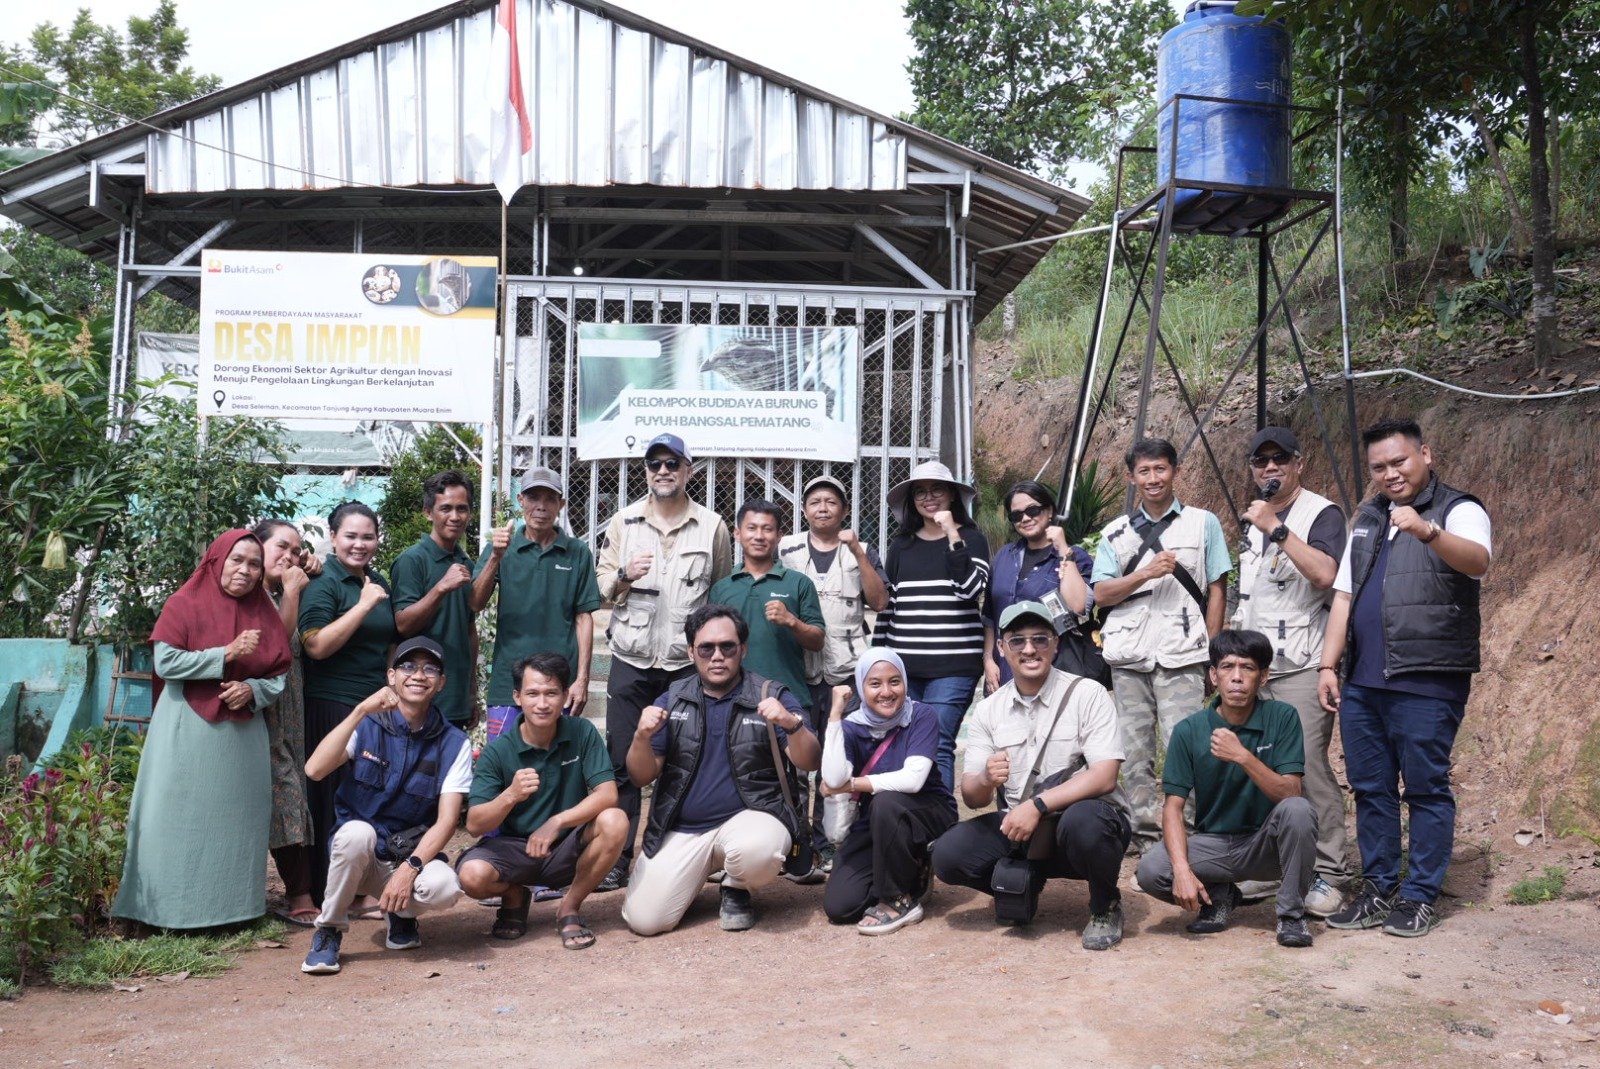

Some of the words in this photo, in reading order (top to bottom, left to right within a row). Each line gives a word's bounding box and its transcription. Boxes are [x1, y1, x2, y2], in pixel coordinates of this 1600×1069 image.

[253, 310, 313, 318] PEMBERDAYAAN
[314, 311, 363, 319] MASYARAKAT
[214, 321, 294, 362] DESA
[306, 323, 421, 365] IMPIAN
[213, 363, 250, 375] Dorong
[252, 364, 292, 374] Ekonomi
[294, 365, 327, 374] Sektor
[329, 366, 378, 376] Agrikultur
[380, 367, 416, 378] dengan
[418, 368, 453, 377] Inovasi
[213, 374, 248, 385] Menuju
[250, 375, 310, 386] Pengelolaan
[311, 376, 365, 387] Lingkungan
[366, 377, 435, 388] Berkelanjutan
[323, 405, 350, 413] Tanjung
[373, 406, 411, 414] Kabupaten
[628, 397, 697, 408] KELOMPOK
[698, 397, 764, 409] BUDIDAYA
[765, 398, 818, 409] BURUNG
[635, 415, 678, 426] PUYUH
[680, 416, 739, 427] BANGSAL
[740, 416, 811, 428] PEMATANG
